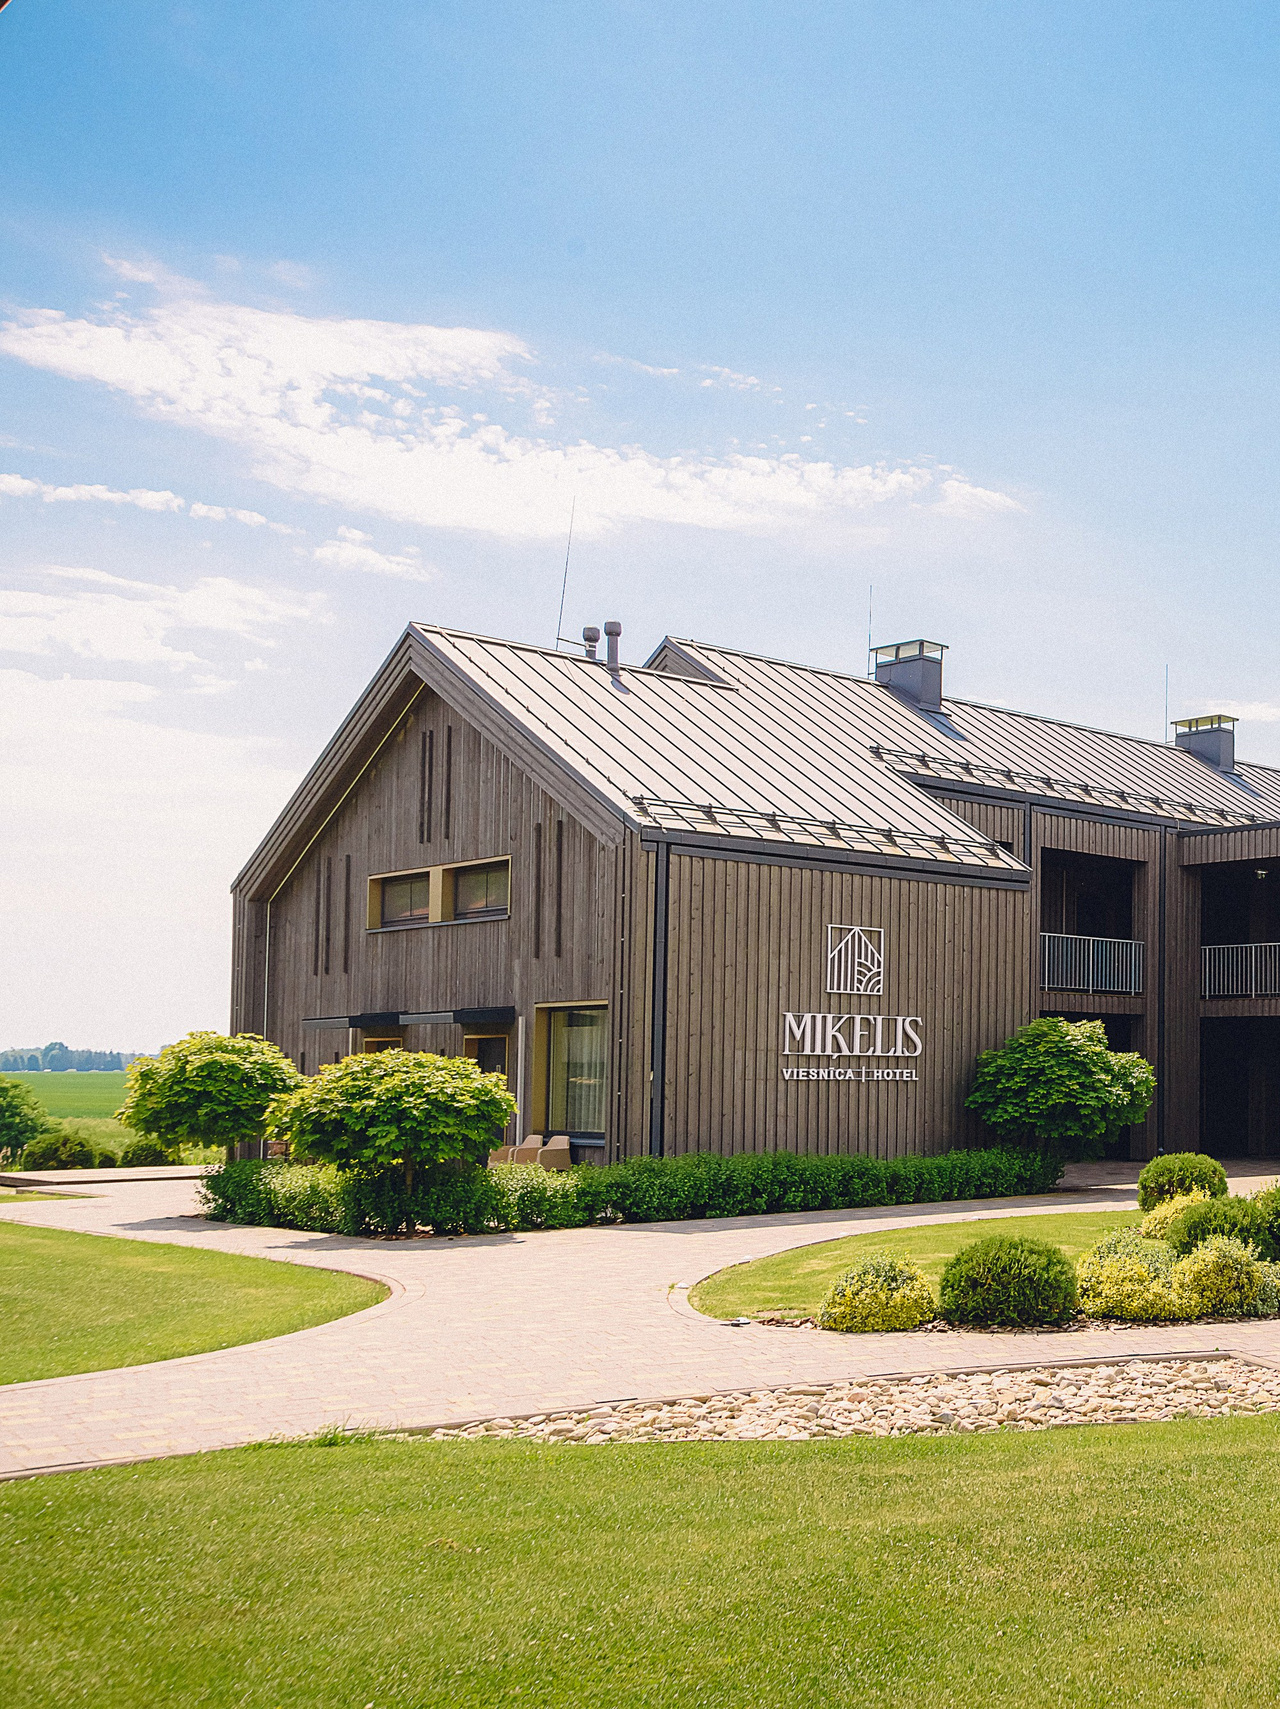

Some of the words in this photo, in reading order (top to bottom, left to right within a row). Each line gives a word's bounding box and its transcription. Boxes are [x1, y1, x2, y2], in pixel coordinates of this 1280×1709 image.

[782, 1012, 923, 1059] MIĶELIS
[782, 1067, 855, 1080] VIESNĪCA
[873, 1069, 919, 1081] HOTEL
